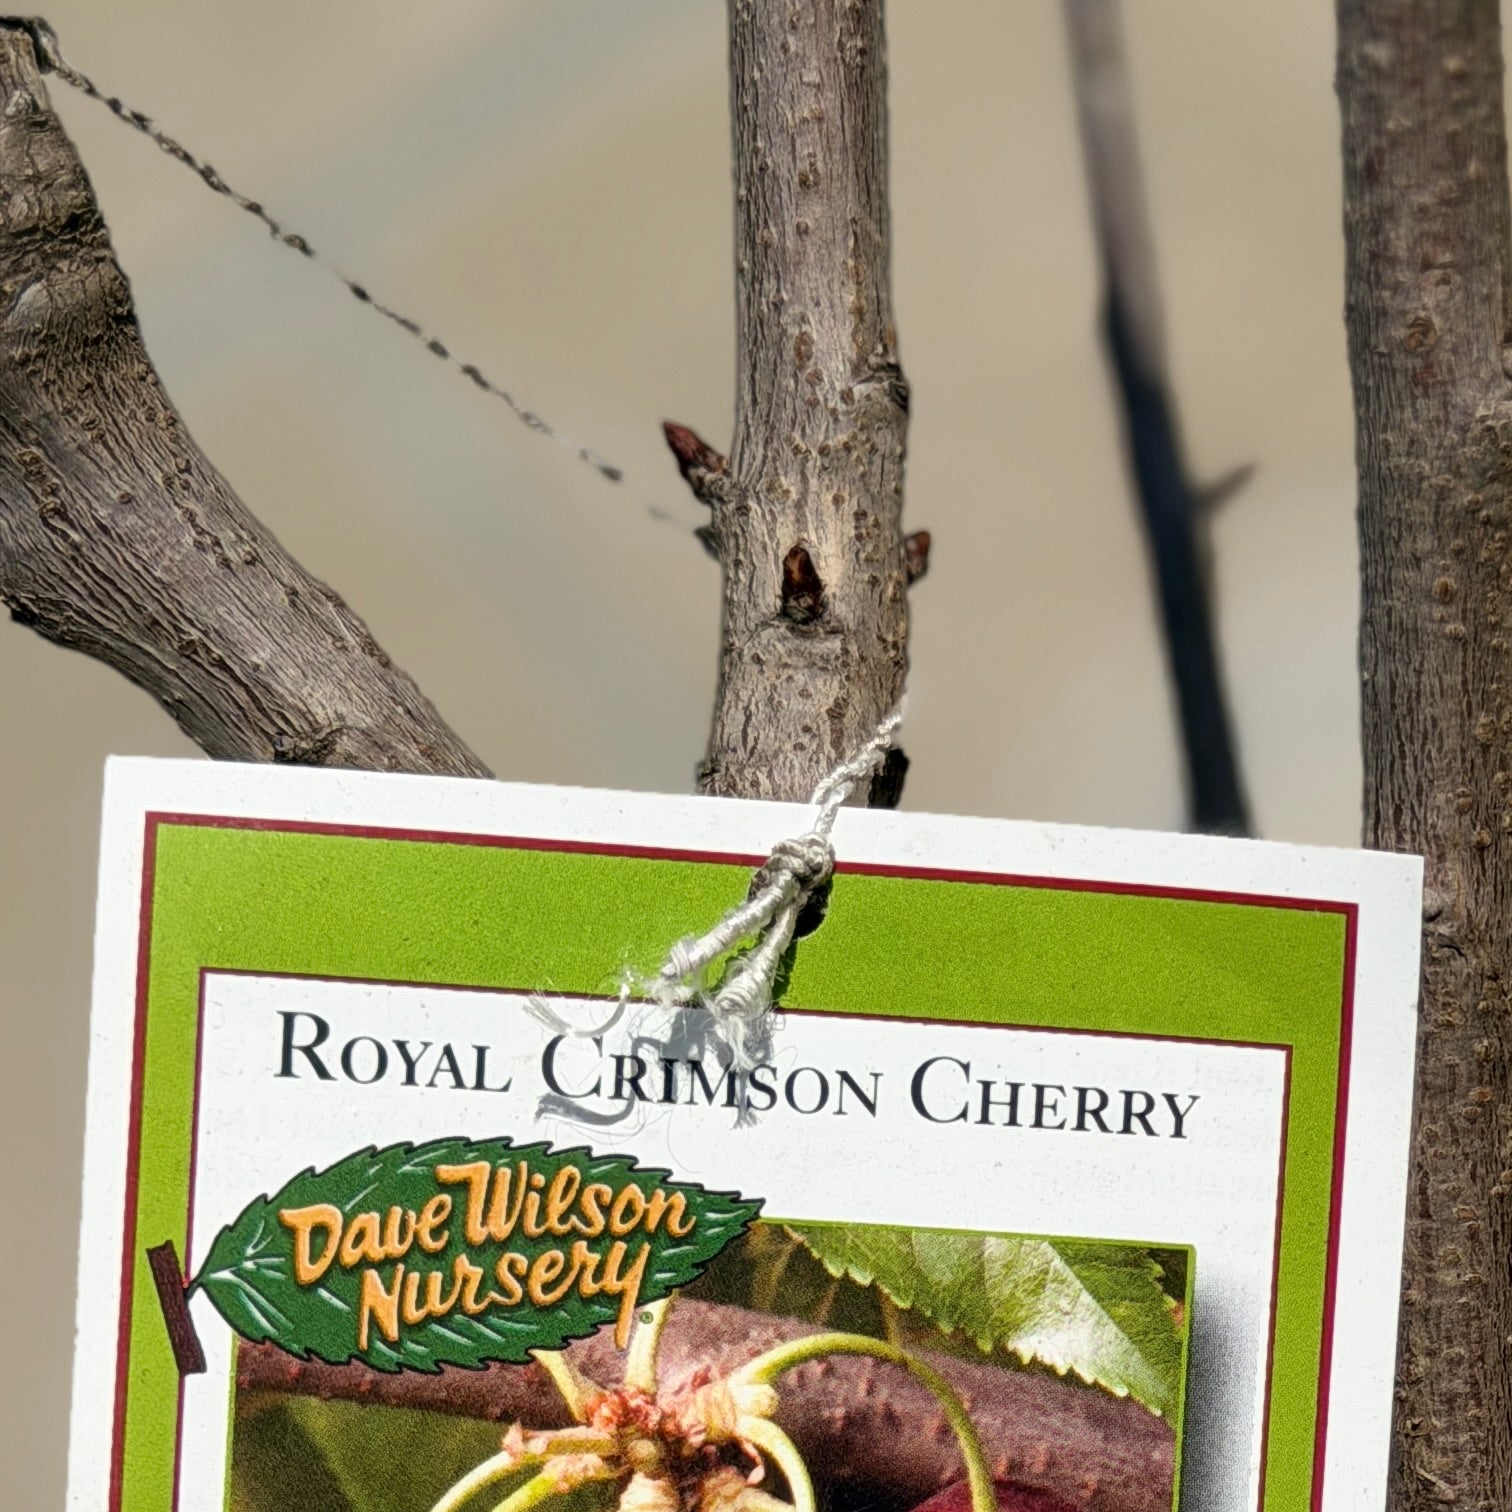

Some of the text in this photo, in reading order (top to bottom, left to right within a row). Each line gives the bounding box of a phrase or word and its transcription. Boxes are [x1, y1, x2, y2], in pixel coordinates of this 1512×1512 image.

[273, 1009, 1201, 1140] ROYAL CRIMSON CHERRY
[280, 1160, 696, 1285] Dave Wilson
[358, 1241, 651, 1352] Nursery
